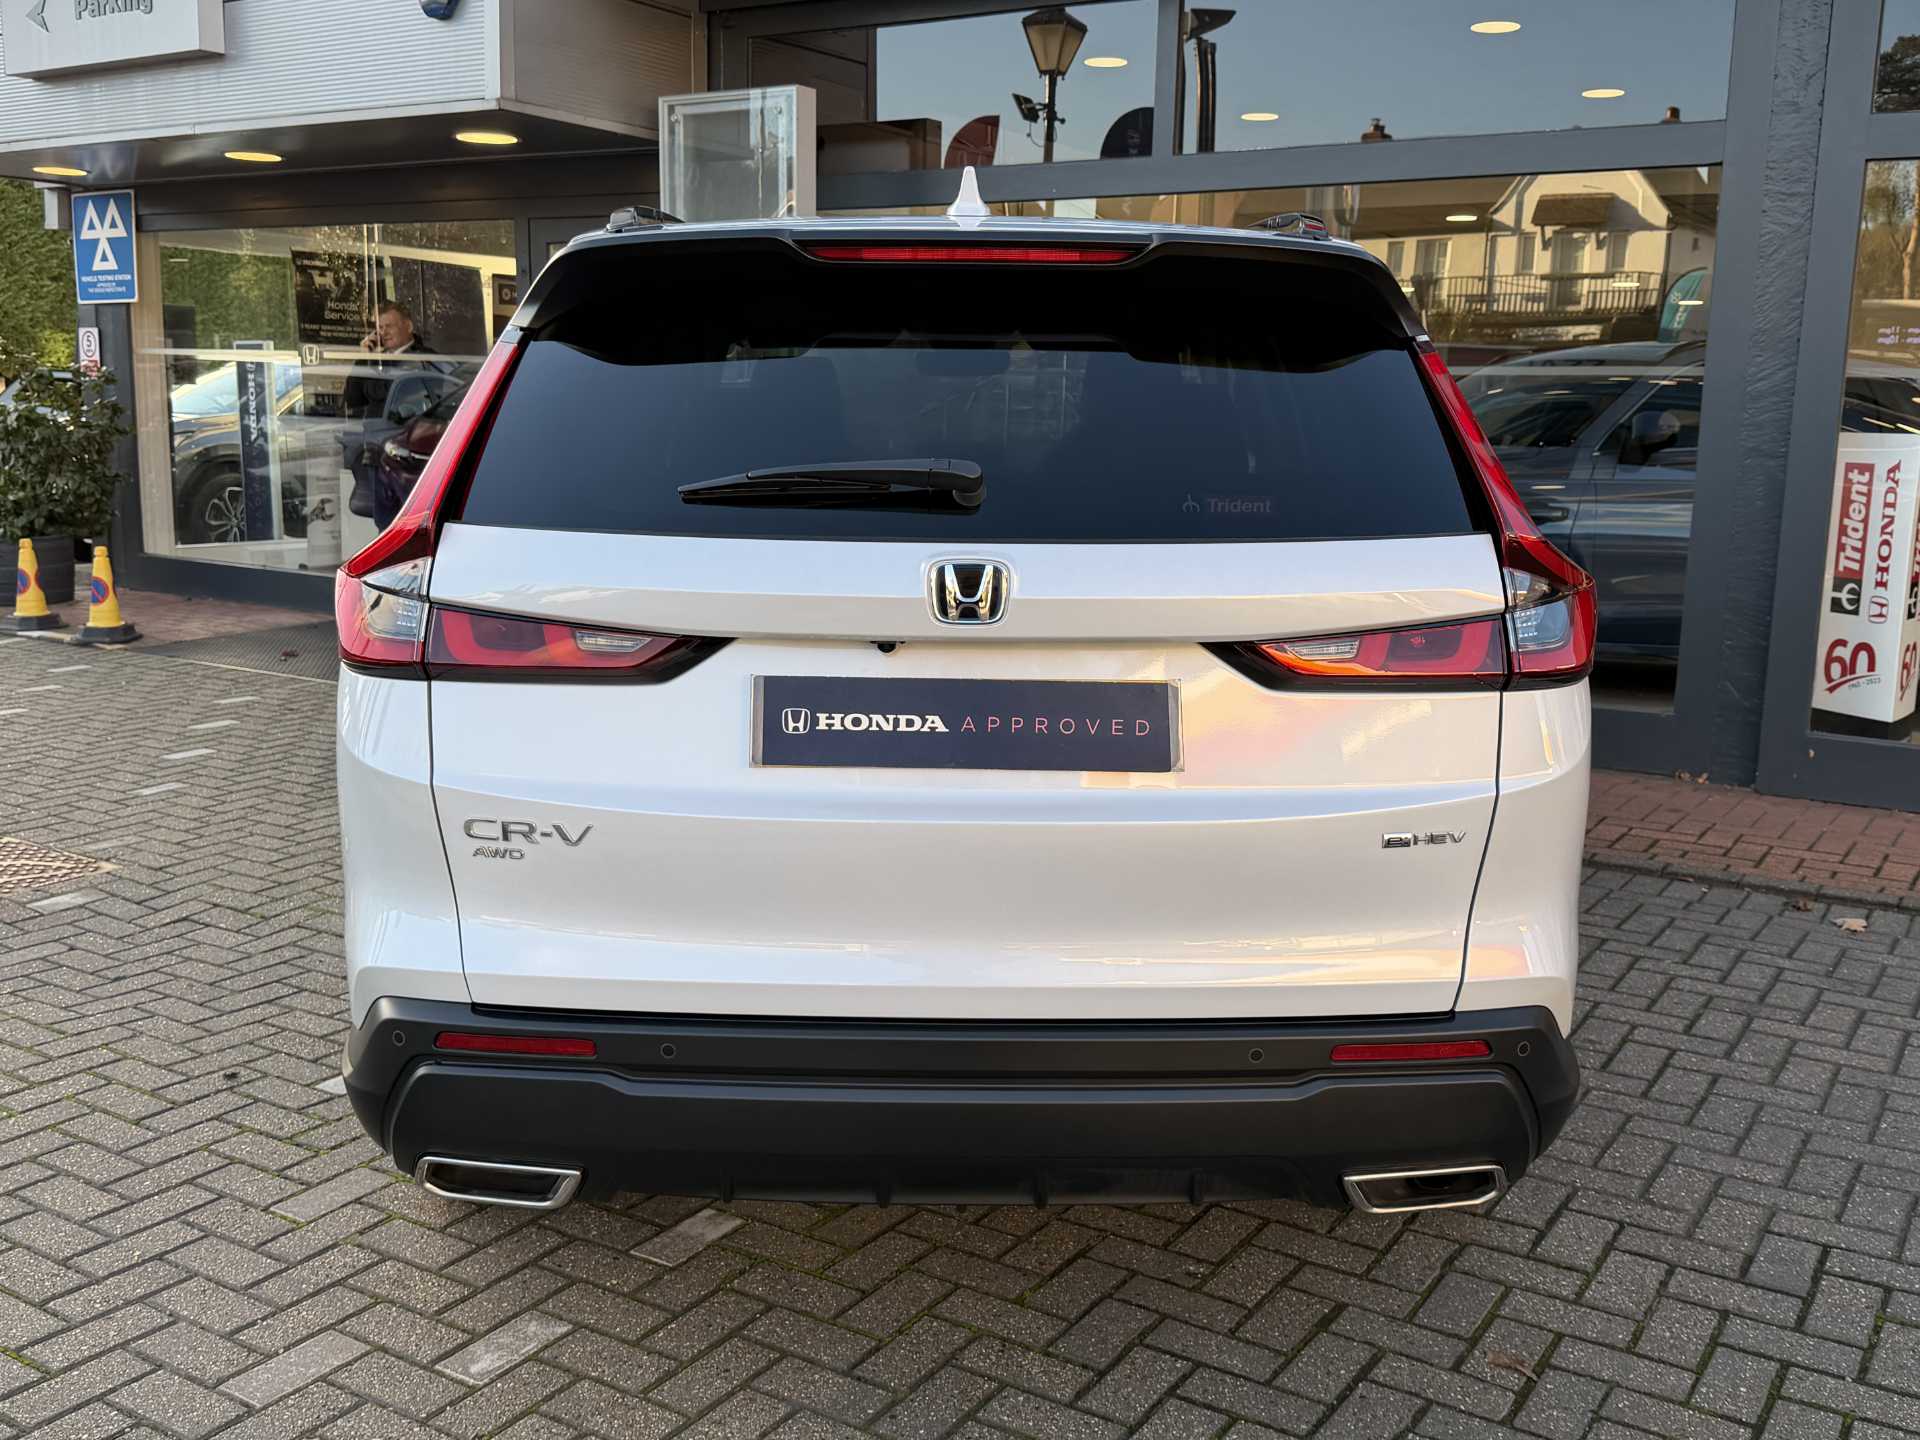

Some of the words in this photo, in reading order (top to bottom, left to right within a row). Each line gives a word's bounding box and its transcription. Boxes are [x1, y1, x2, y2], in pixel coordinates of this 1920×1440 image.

[73, 0, 154, 20] Parking
[324, 310, 361, 321] Service
[86, 334, 92, 348] 5
[247, 373, 258, 442] HONDA
[1208, 497, 1272, 513] Trident
[1838, 468, 1871, 573] Trident
[1874, 459, 1902, 591] HONDA
[1824, 638, 1876, 686] 60
[815, 712, 950, 734] HONDA
[960, 715, 1151, 737] APPROVED
[463, 818, 594, 847] CR-V
[472, 845, 526, 860] AWD
